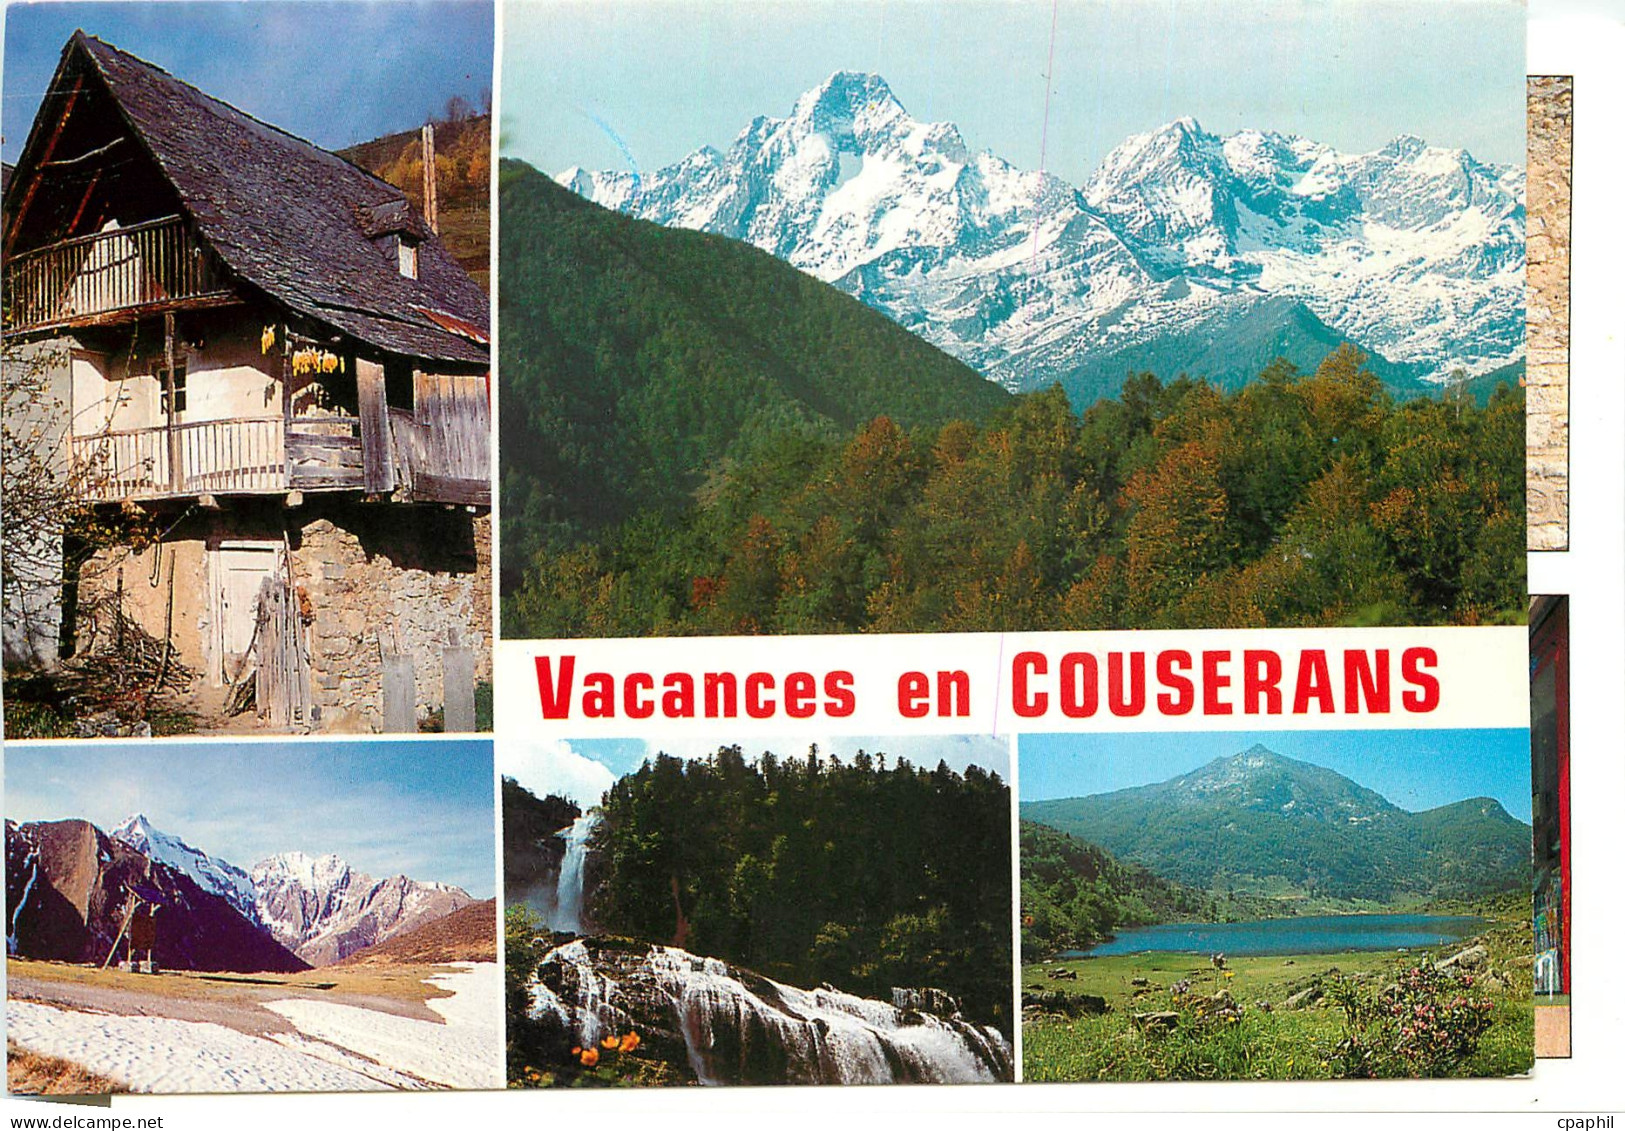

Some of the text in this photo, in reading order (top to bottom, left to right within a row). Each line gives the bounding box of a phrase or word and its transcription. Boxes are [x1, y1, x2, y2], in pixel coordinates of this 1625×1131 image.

[534, 646, 1440, 720] Vacances en COUSERANS
